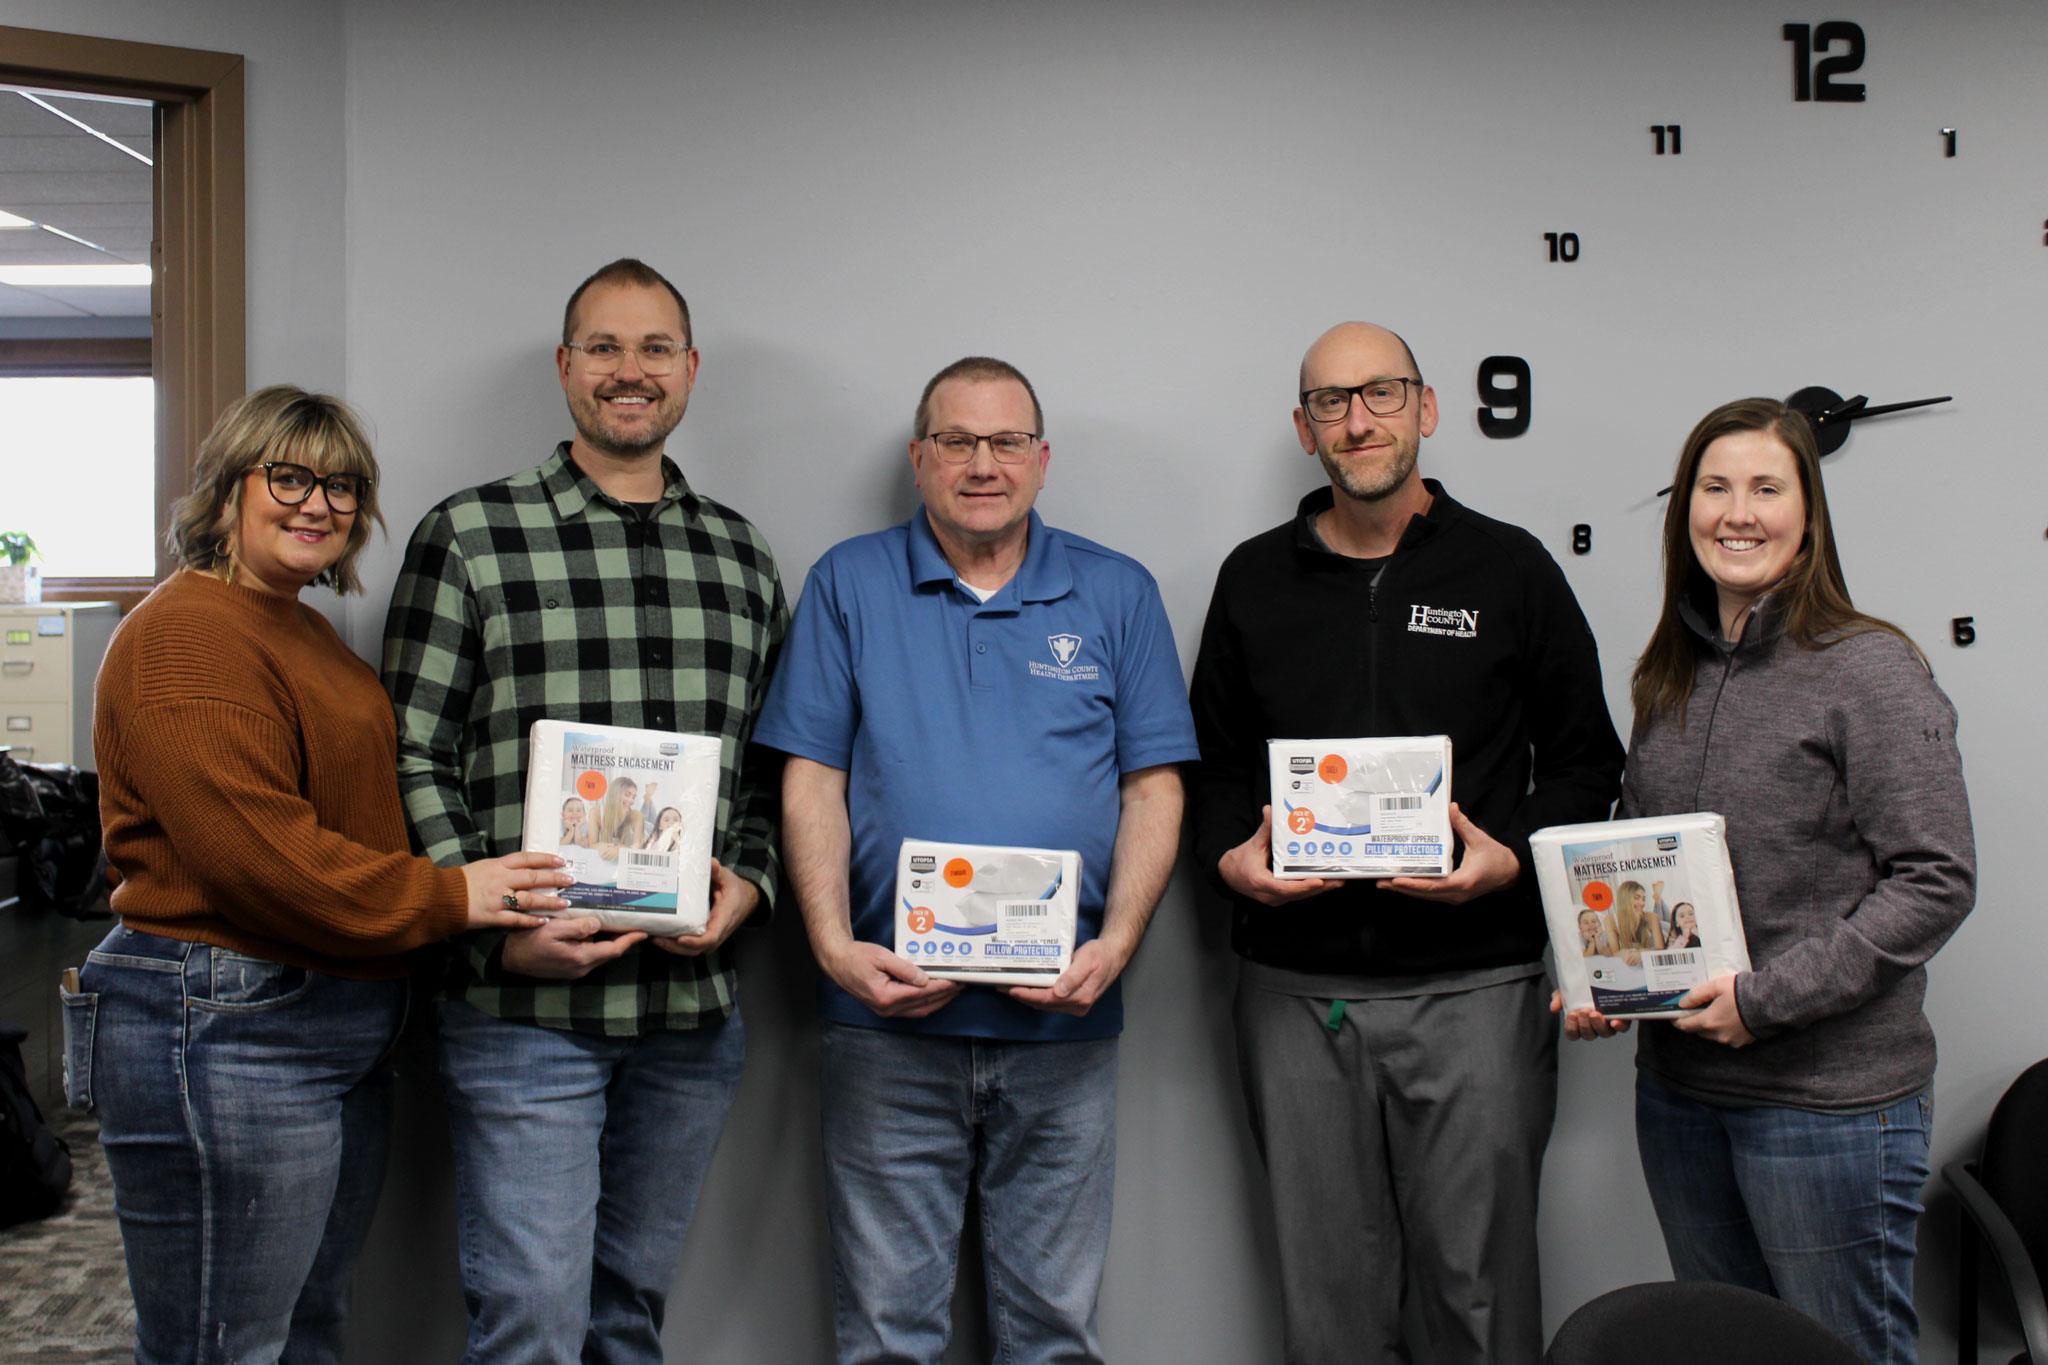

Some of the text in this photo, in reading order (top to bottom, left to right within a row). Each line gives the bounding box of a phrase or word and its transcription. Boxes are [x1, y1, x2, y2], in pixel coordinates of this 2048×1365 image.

[1783, 21, 1866, 102] 12
[1650, 125, 1681, 155] 11
[1941, 127, 1956, 158] 1
[1544, 232, 1580, 262] 10
[1477, 356, 1531, 439] 9
[1572, 524, 1592, 555] 8
[1427, 616, 1460, 626] COUNTY
[1407, 625, 1446, 636] DEPARTMENT
[1455, 630, 1477, 638] HEALTH
[1952, 617, 1976, 645] 5
[1030, 668, 1099, 681] HEALTH DEPARTMENT
[1072, 666, 1098, 674] COUNTY
[572, 745, 615, 754] Waterproof
[571, 754, 675, 772] MATTRESS ENCASEMENT
[1296, 817, 1307, 832] 2
[1411, 835, 1439, 843] ZIPPERED
[1366, 845, 1439, 855] PILLOW PROTECTORS
[1572, 852, 1614, 864] Waterproof
[1574, 855, 1677, 877] MATTRESS ENCASEMENT
[916, 916, 926, 930] 2
[986, 945, 1058, 956] PILLOW PROTECTORS
